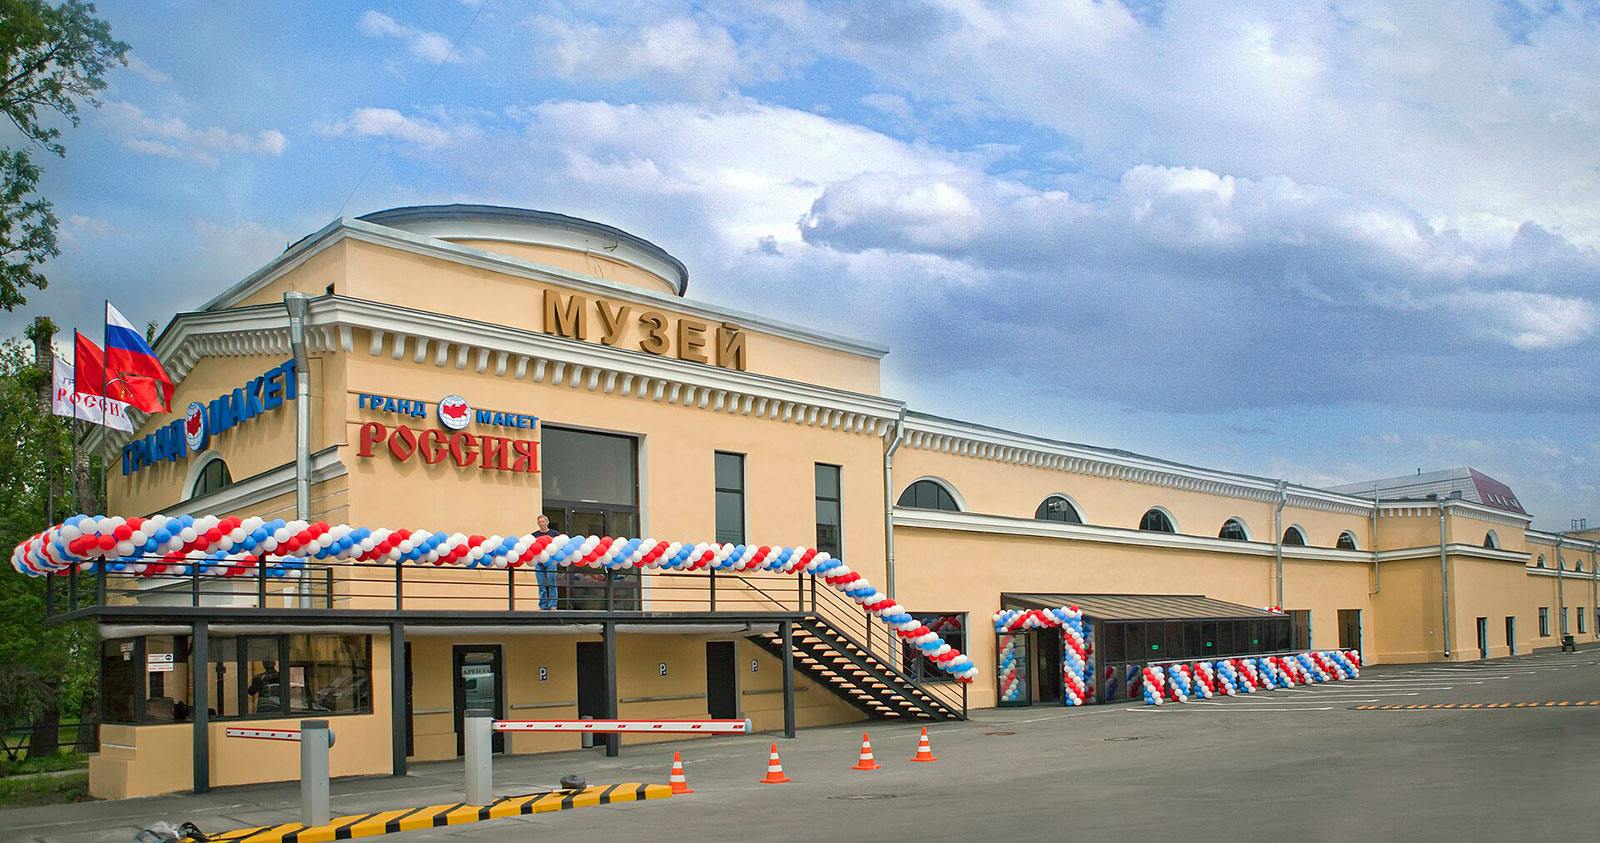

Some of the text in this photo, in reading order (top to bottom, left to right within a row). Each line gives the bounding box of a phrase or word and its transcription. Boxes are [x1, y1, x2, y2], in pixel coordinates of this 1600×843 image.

[542, 288, 748, 371] МУЗЕЙ
[122, 358, 296, 476] ГРАНД МАКЕТ
[358, 393, 539, 429] ГРАНД МАКЕТ
[356, 421, 541, 474] РОССИЯ
